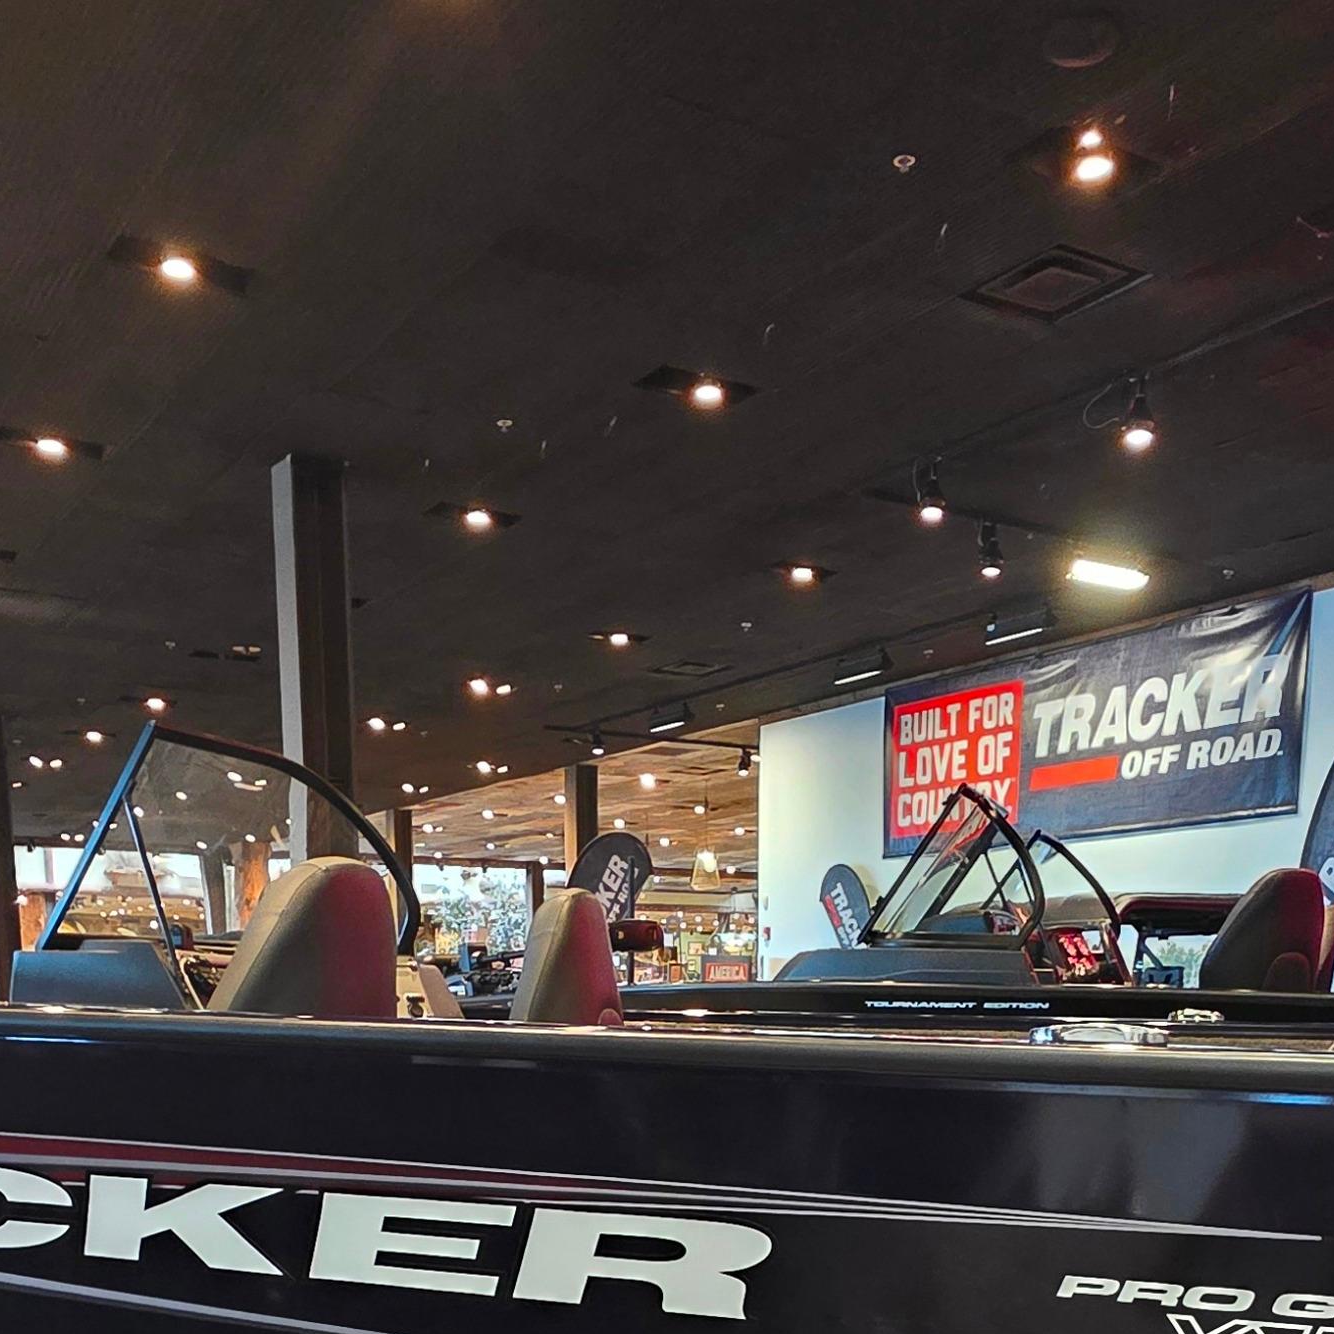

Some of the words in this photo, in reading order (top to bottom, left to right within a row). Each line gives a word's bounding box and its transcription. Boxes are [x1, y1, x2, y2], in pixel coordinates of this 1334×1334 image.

[899, 705, 961, 747] BUILT
[969, 692, 1015, 732] FOR
[1033, 654, 1289, 758] TRACKER
[898, 739, 968, 788] LOVE
[977, 731, 1014, 776] OF
[1121, 745, 1182, 780] OFF
[709, 965, 747, 980] AMERICA
[865, 1001, 977, 1009] TOURNAMENT
[1056, 1275, 1256, 1312] PRO
